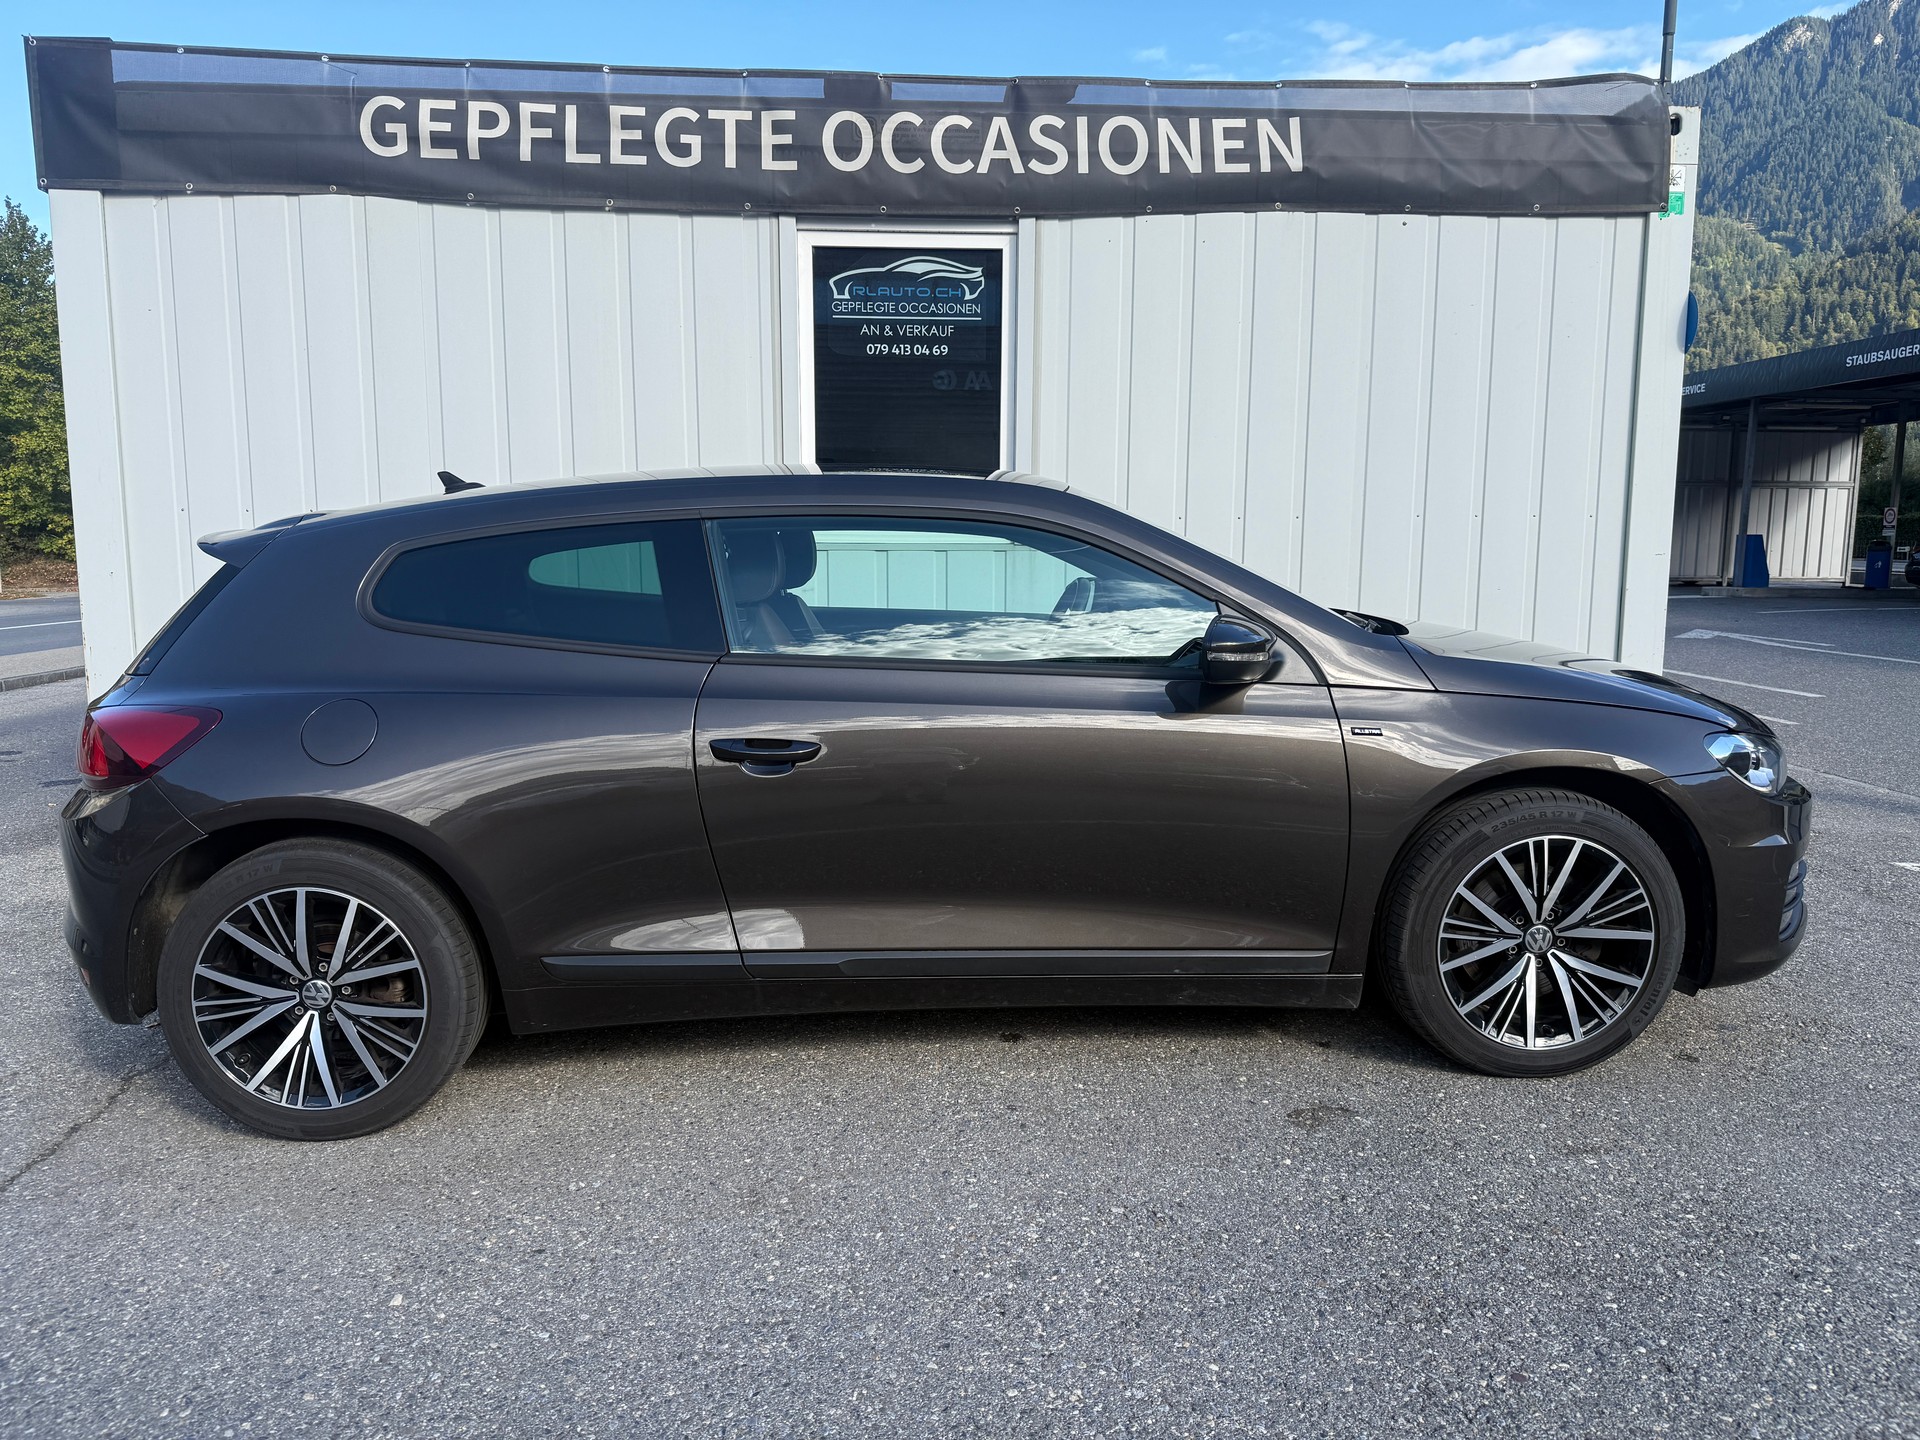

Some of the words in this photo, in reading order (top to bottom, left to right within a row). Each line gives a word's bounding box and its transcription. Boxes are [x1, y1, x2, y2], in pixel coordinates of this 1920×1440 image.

[359, 95, 799, 174] GEPFLEGTE
[821, 110, 1304, 176] OCCASIONEN
[852, 286, 963, 298] RLAUTO.CH
[831, 300, 896, 314] GEPFLEGTE
[898, 302, 981, 314] OCCASIONEN
[860, 323, 880, 336] AN
[884, 324, 894, 337] &
[897, 324, 955, 337] VERKAUF
[866, 343, 889, 355] 079
[891, 344, 911, 356] 413
[913, 344, 930, 356] 04
[932, 344, 949, 356] 69
[1845, 344, 1920, 367] STAUBSAUGER
[1490, 811, 1537, 833] 235/45
